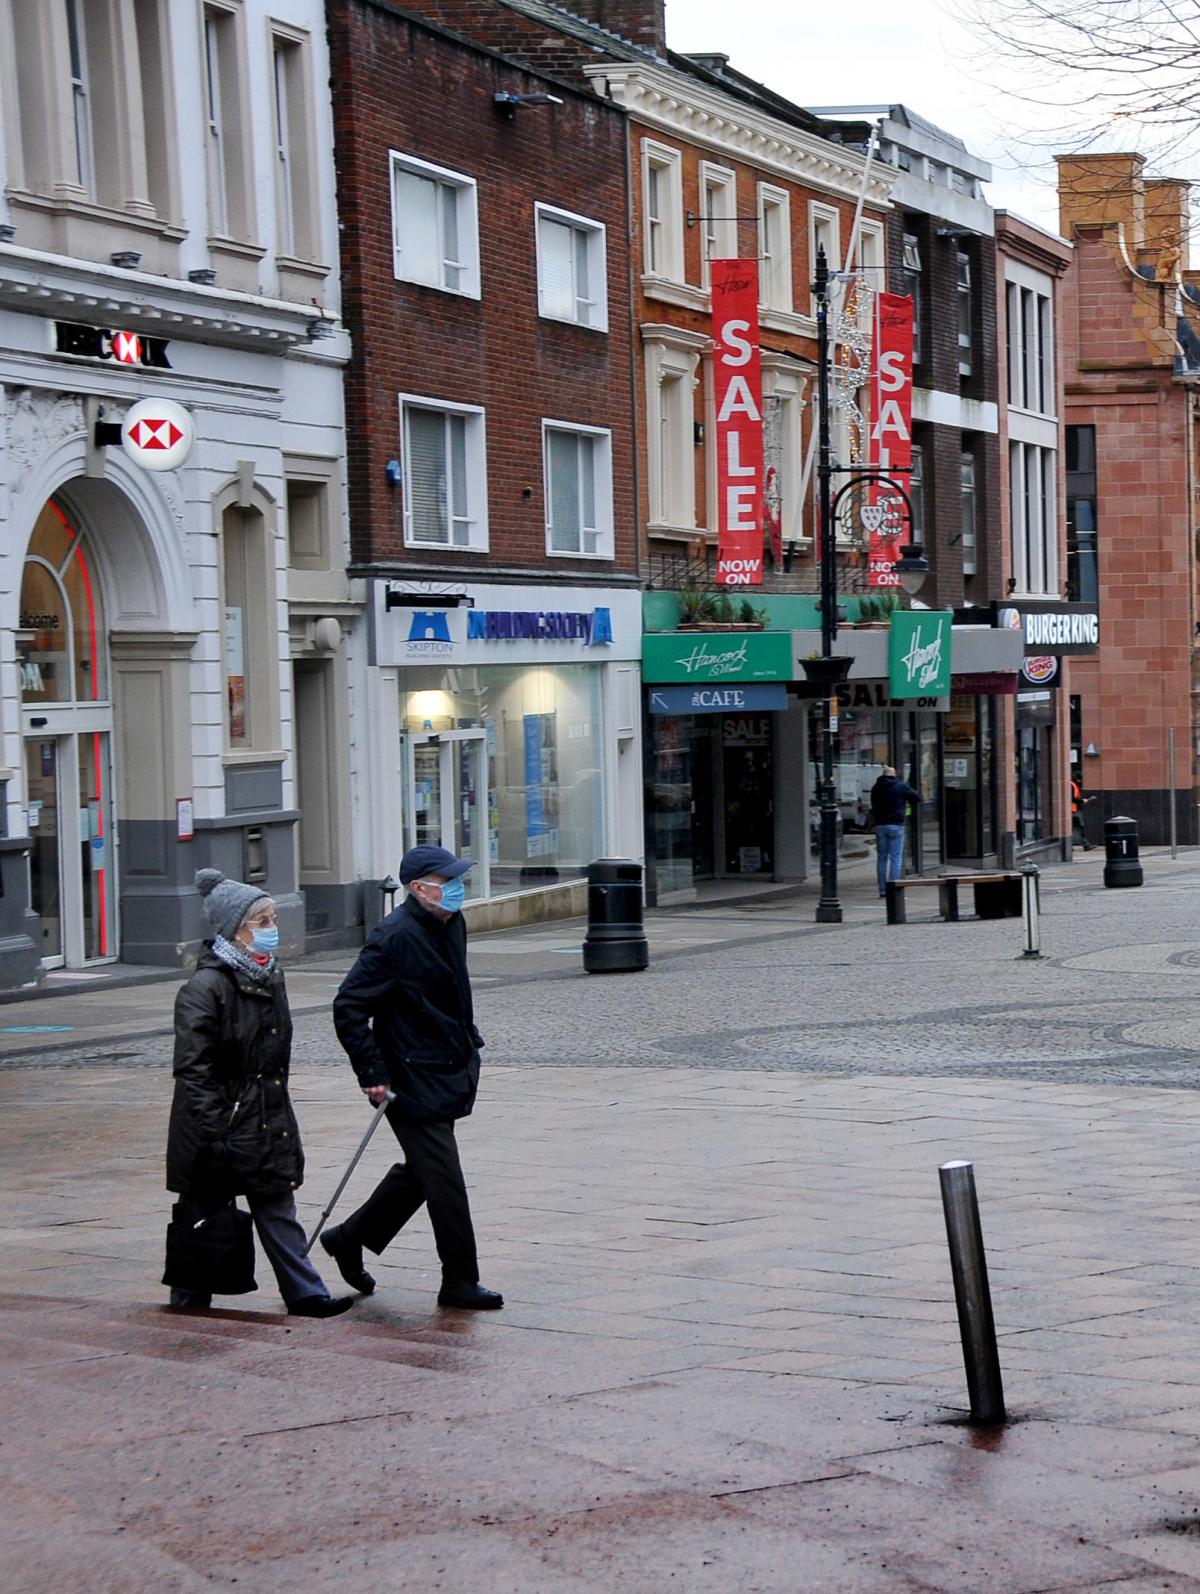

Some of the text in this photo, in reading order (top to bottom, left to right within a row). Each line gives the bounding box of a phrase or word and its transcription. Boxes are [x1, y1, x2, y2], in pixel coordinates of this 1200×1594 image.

[717, 319, 761, 531] SALE
[719, 559, 760, 572] NOW
[870, 561, 897, 573] NO
[725, 573, 751, 584] ON
[877, 574, 900, 585] ON
[19, 609, 60, 628] elcome
[1026, 614, 1071, 645] BURGER
[1071, 613, 1099, 643] KING
[406, 642, 453, 652] SKIPTON
[674, 638, 749, 673] Hancock
[1028, 660, 1054, 675] KING
[700, 690, 745, 707] CAFE
[917, 697, 938, 708] ON
[723, 719, 770, 738] SALE
